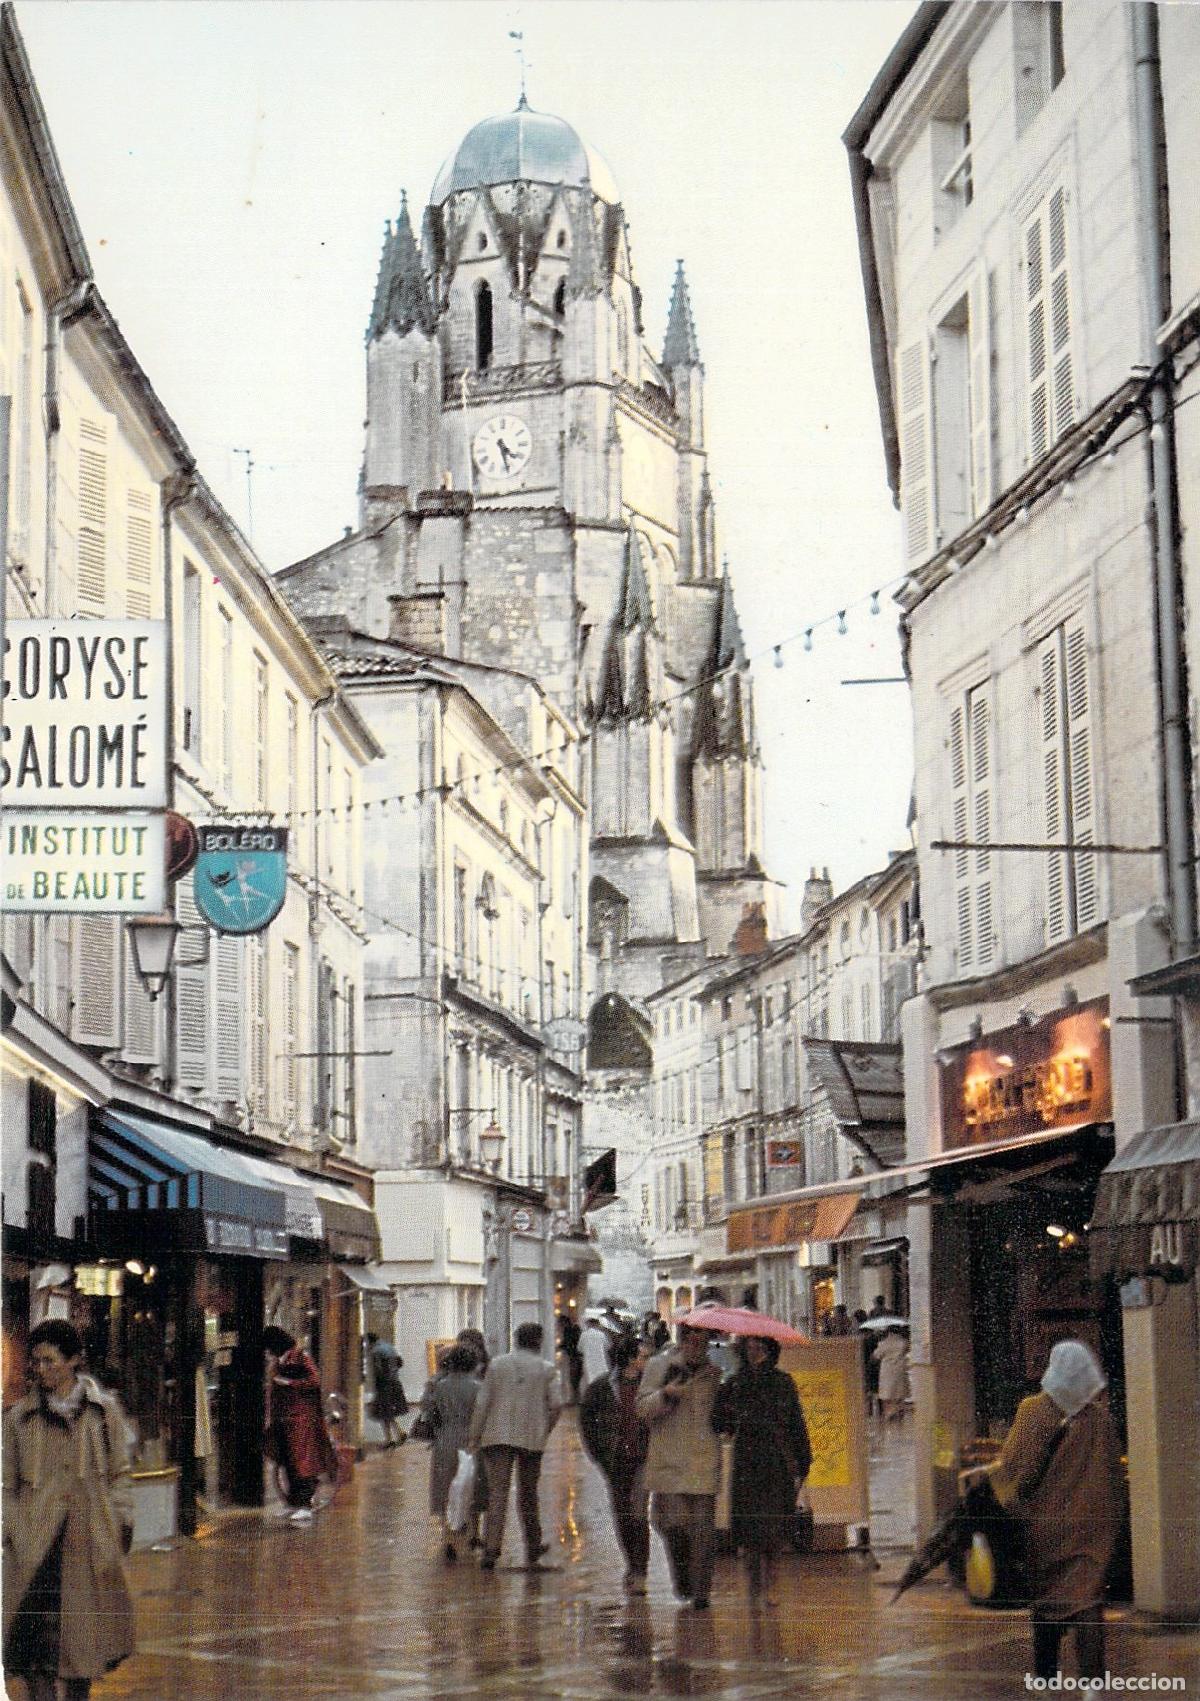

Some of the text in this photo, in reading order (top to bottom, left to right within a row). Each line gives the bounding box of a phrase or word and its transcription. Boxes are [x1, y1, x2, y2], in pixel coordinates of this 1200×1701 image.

[8, 825, 148, 856] INSTITUT
[6, 871, 146, 900] DE BEAUTE
[1150, 1224, 1183, 1265] AU
